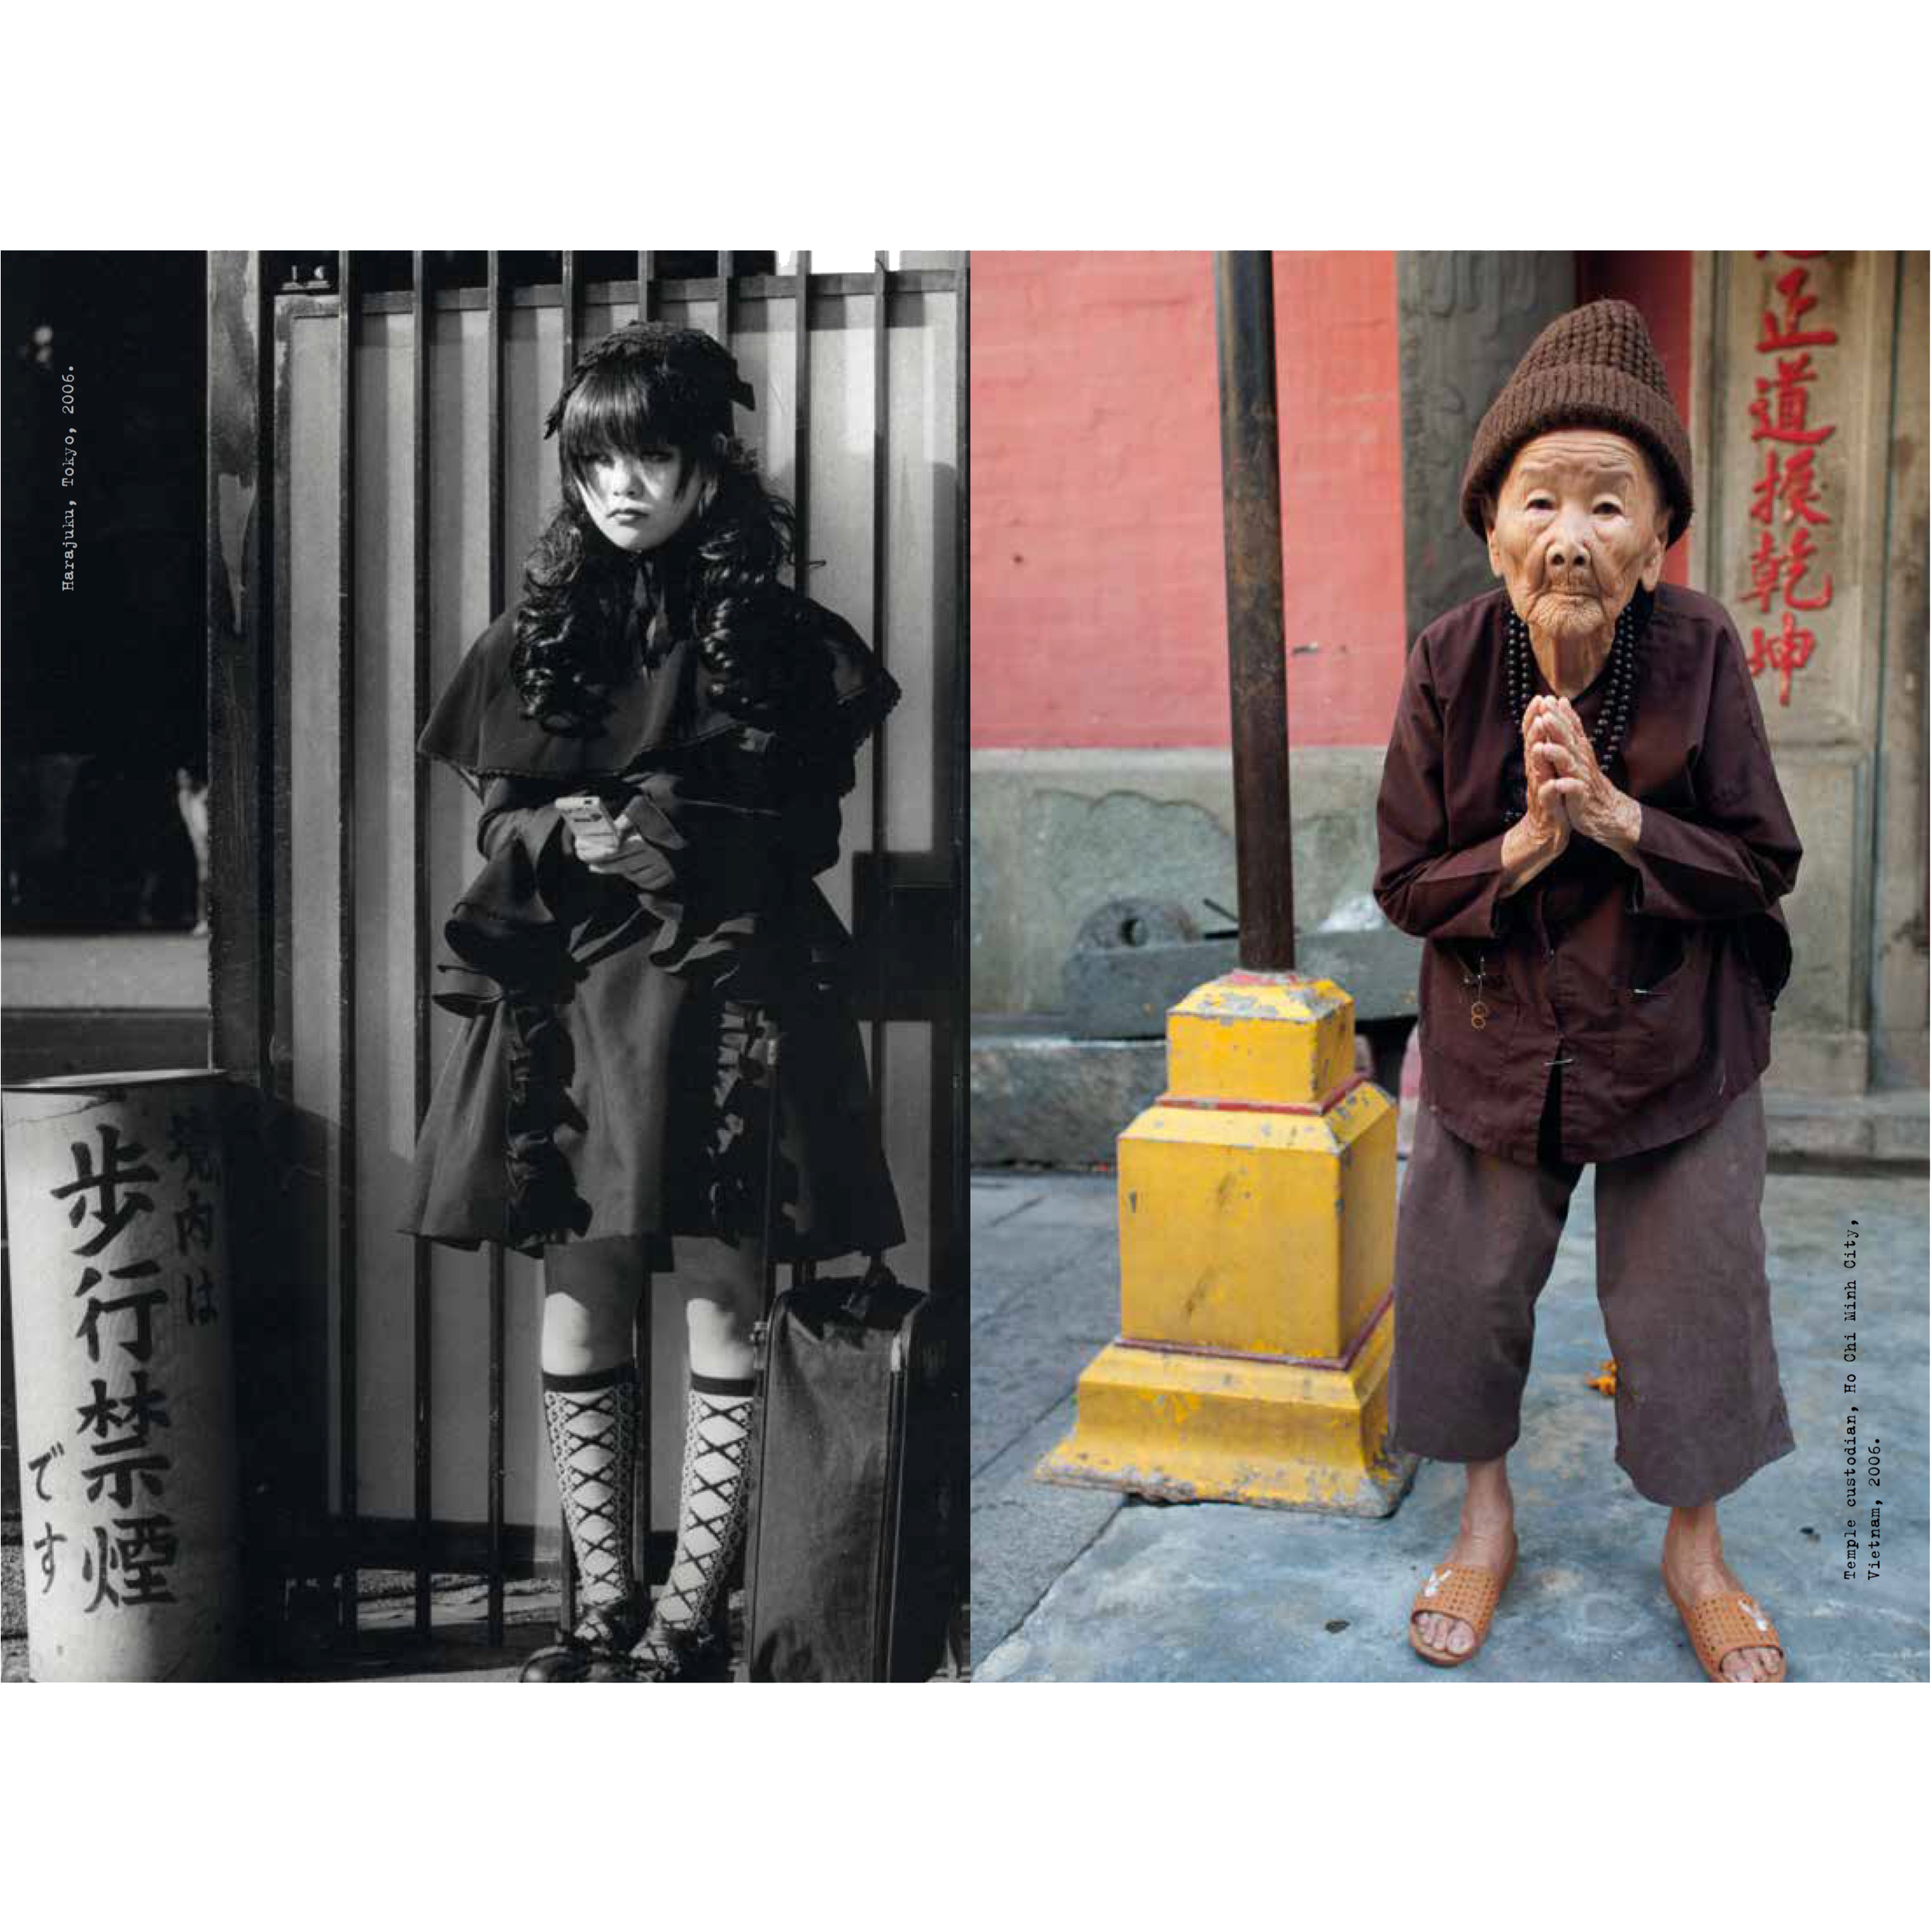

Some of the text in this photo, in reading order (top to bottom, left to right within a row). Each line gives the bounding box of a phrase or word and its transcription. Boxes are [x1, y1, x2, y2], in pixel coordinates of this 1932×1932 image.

[28, 1440, 68, 1594] です
[50, 1123, 179, 1614] 歩行禁煙
